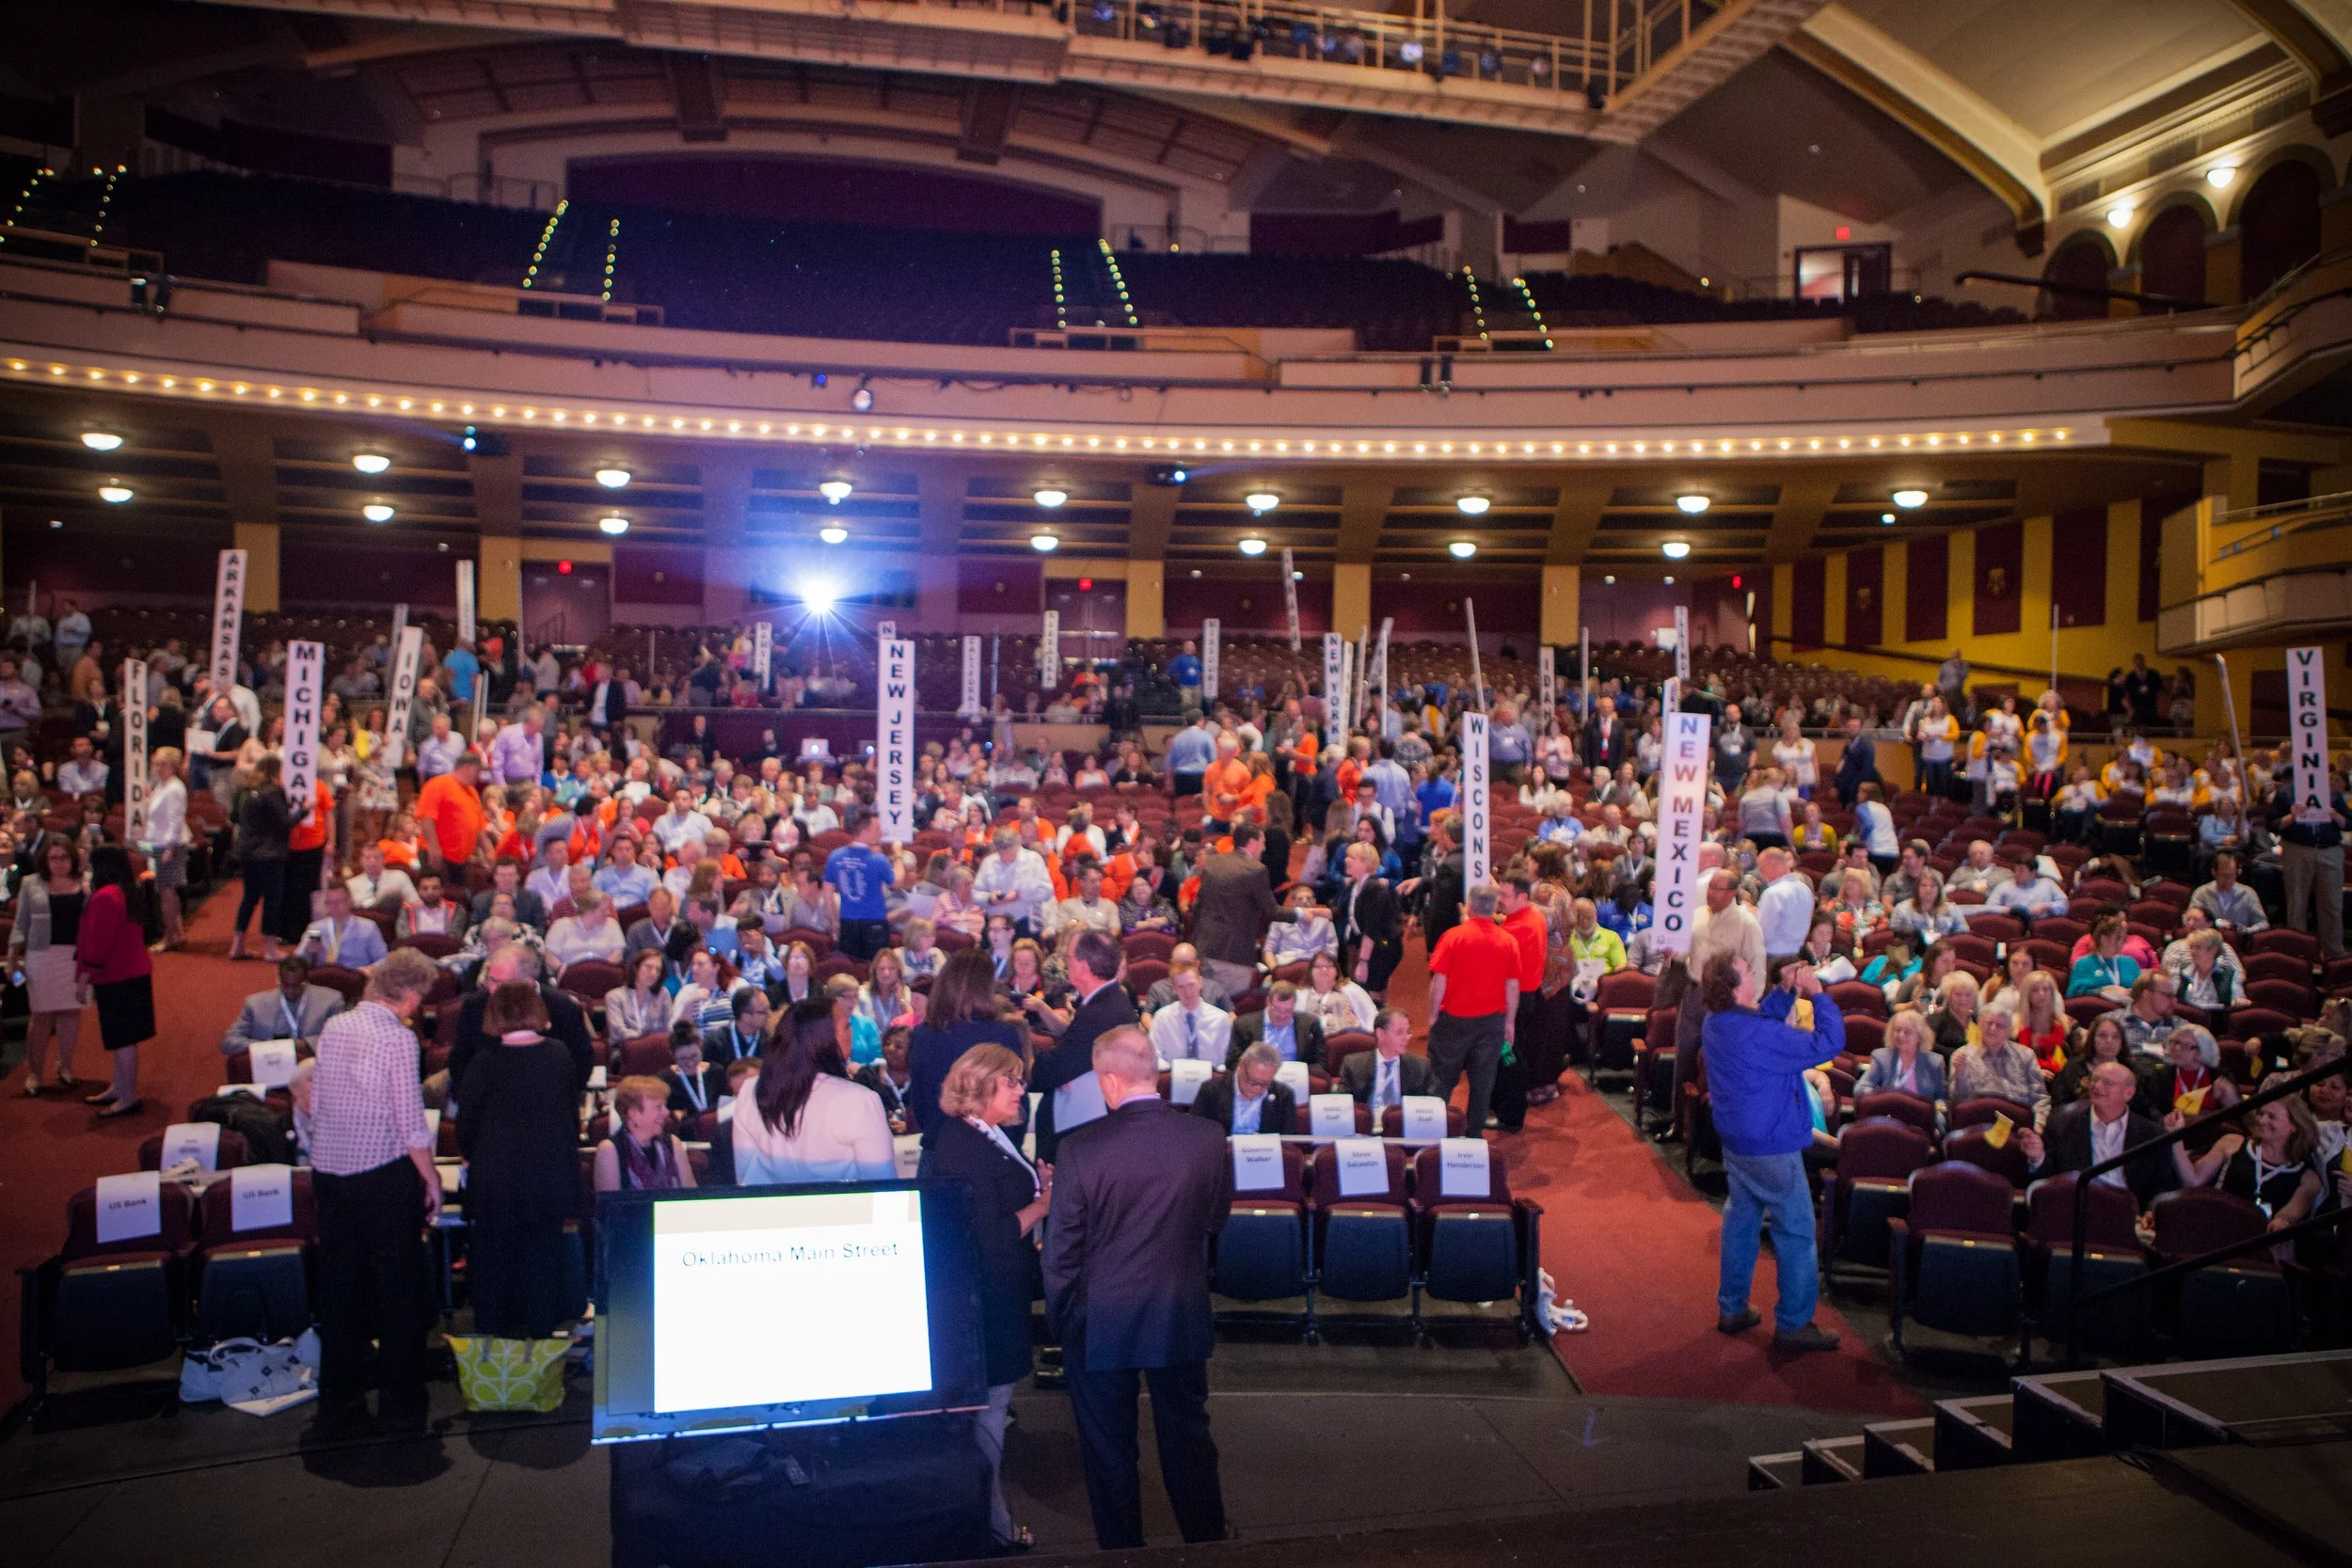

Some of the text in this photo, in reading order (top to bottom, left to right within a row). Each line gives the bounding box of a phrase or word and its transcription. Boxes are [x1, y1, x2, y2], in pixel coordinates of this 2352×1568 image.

[218, 554, 239, 676] ARKANSAS
[391, 652, 414, 733] IOWA
[887, 643, 907, 699] NEW
[967, 637, 977, 709] CALIFORNI
[1329, 635, 1340, 735] NEW YORK
[131, 661, 142, 828] FLORIDA
[290, 644, 315, 809] MICHIGAN
[889, 710, 904, 826] JERSEY
[1674, 716, 1698, 783] NEW
[2296, 649, 2322, 810] VIRGINIA
[1470, 715, 1484, 879] WISCONS
[1664, 796, 1693, 932] MEXICO
[108, 1198, 148, 1211] US Bank
[242, 1188, 279, 1199] US Bank
[682, 1243, 898, 1267] Oklahoma Main Street
